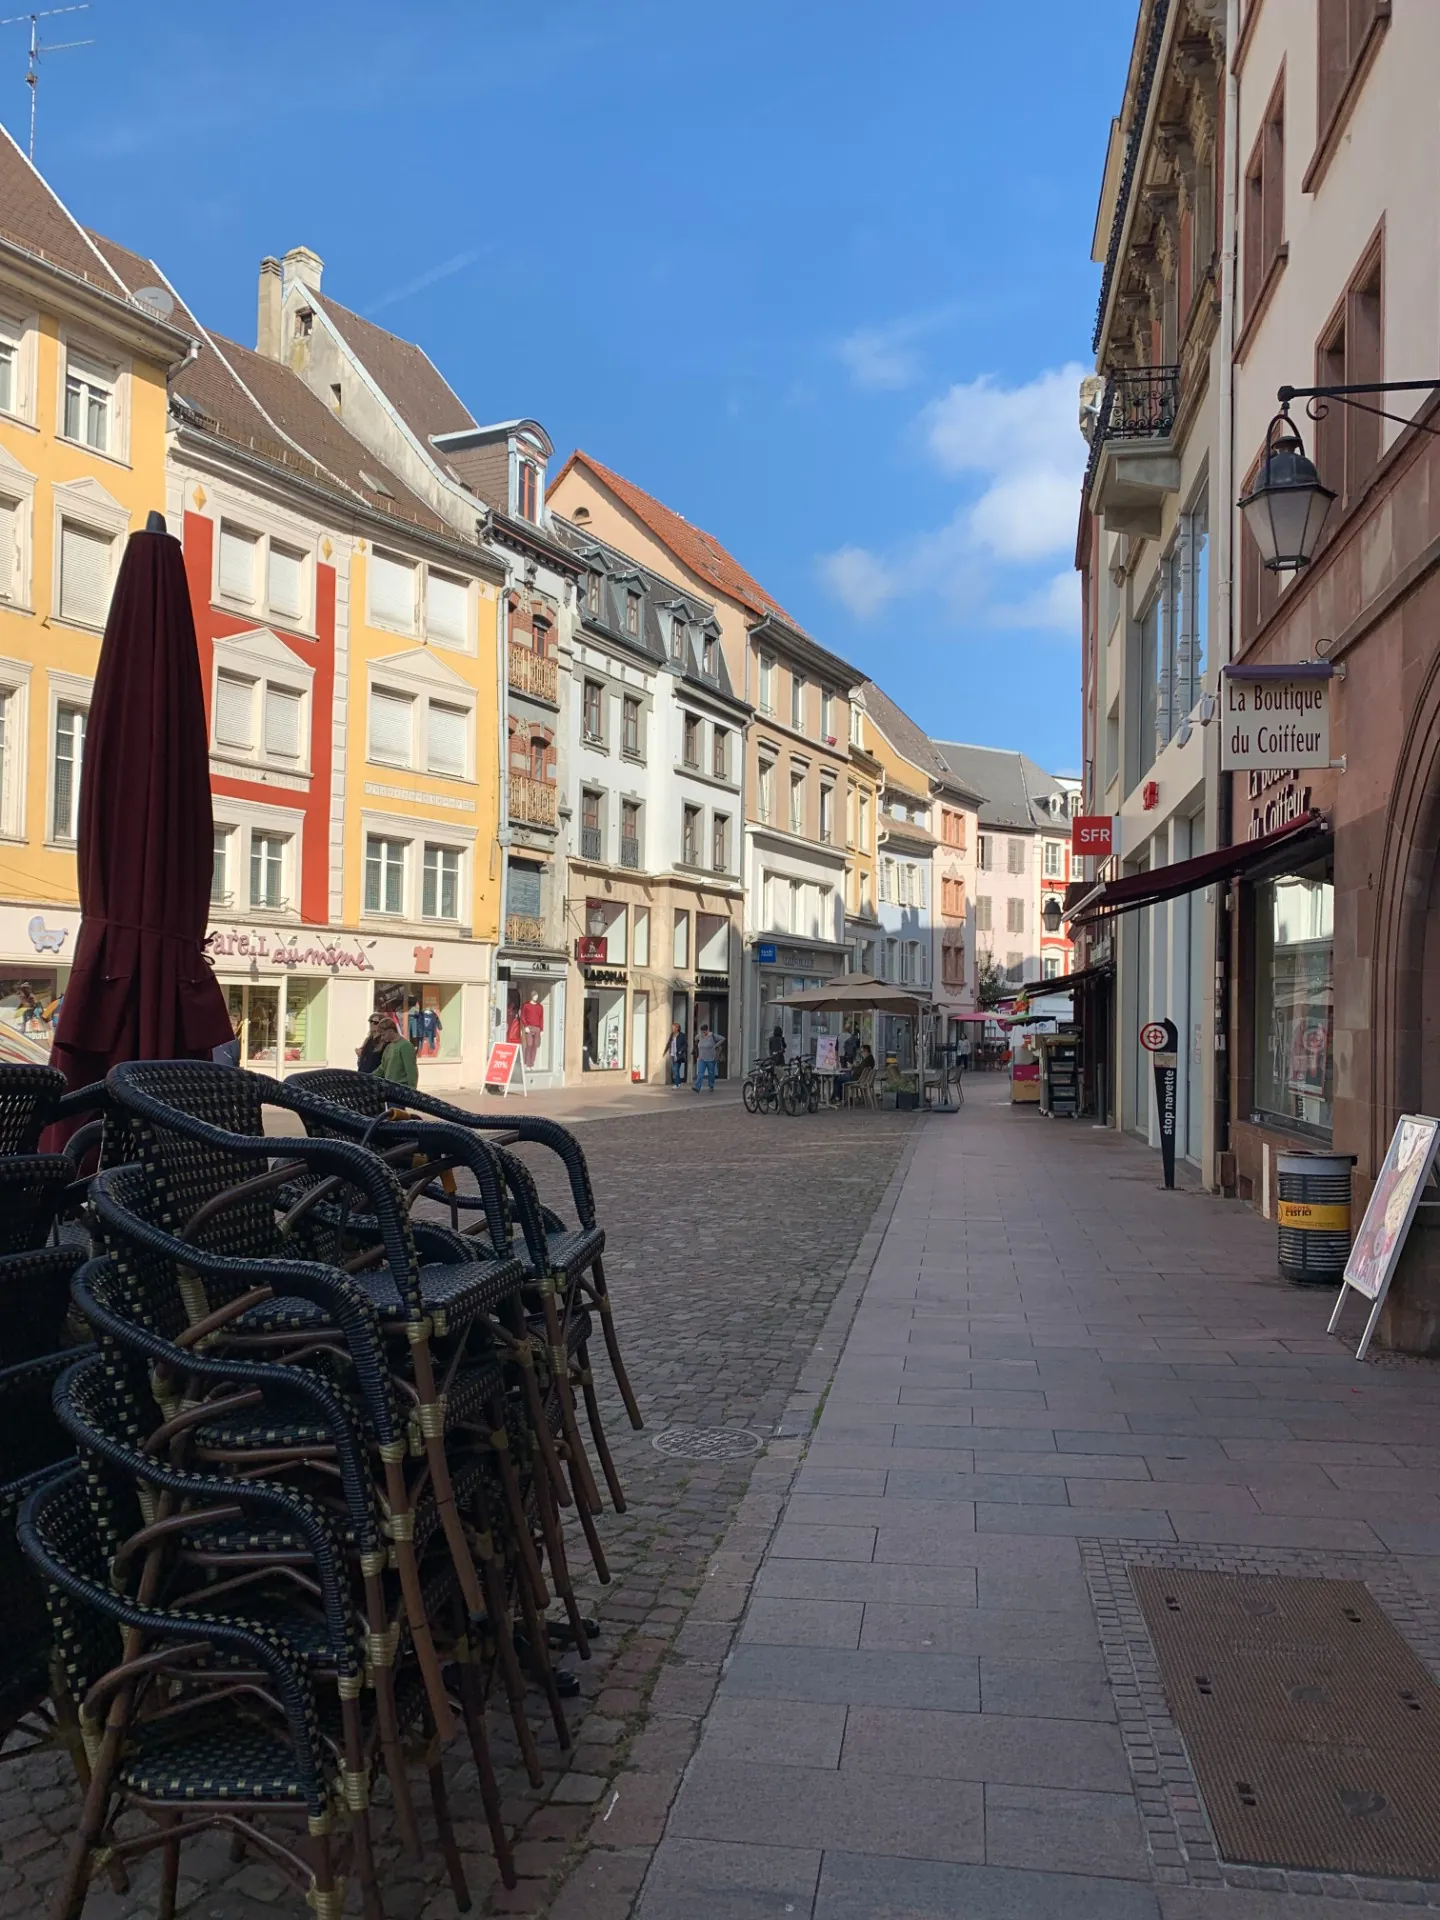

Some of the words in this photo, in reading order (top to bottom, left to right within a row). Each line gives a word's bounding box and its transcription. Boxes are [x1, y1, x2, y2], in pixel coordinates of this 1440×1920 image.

[1229, 686, 1246, 711] La
[1254, 683, 1322, 717] Boutique
[1231, 725, 1249, 754] du
[1257, 724, 1321, 753] Coiffeur
[1263, 784, 1306, 836] Coiffeur
[1080, 828, 1110, 843] SFR
[1164, 1069, 1174, 1109] navette
[1163, 1110, 1175, 1135] stop
